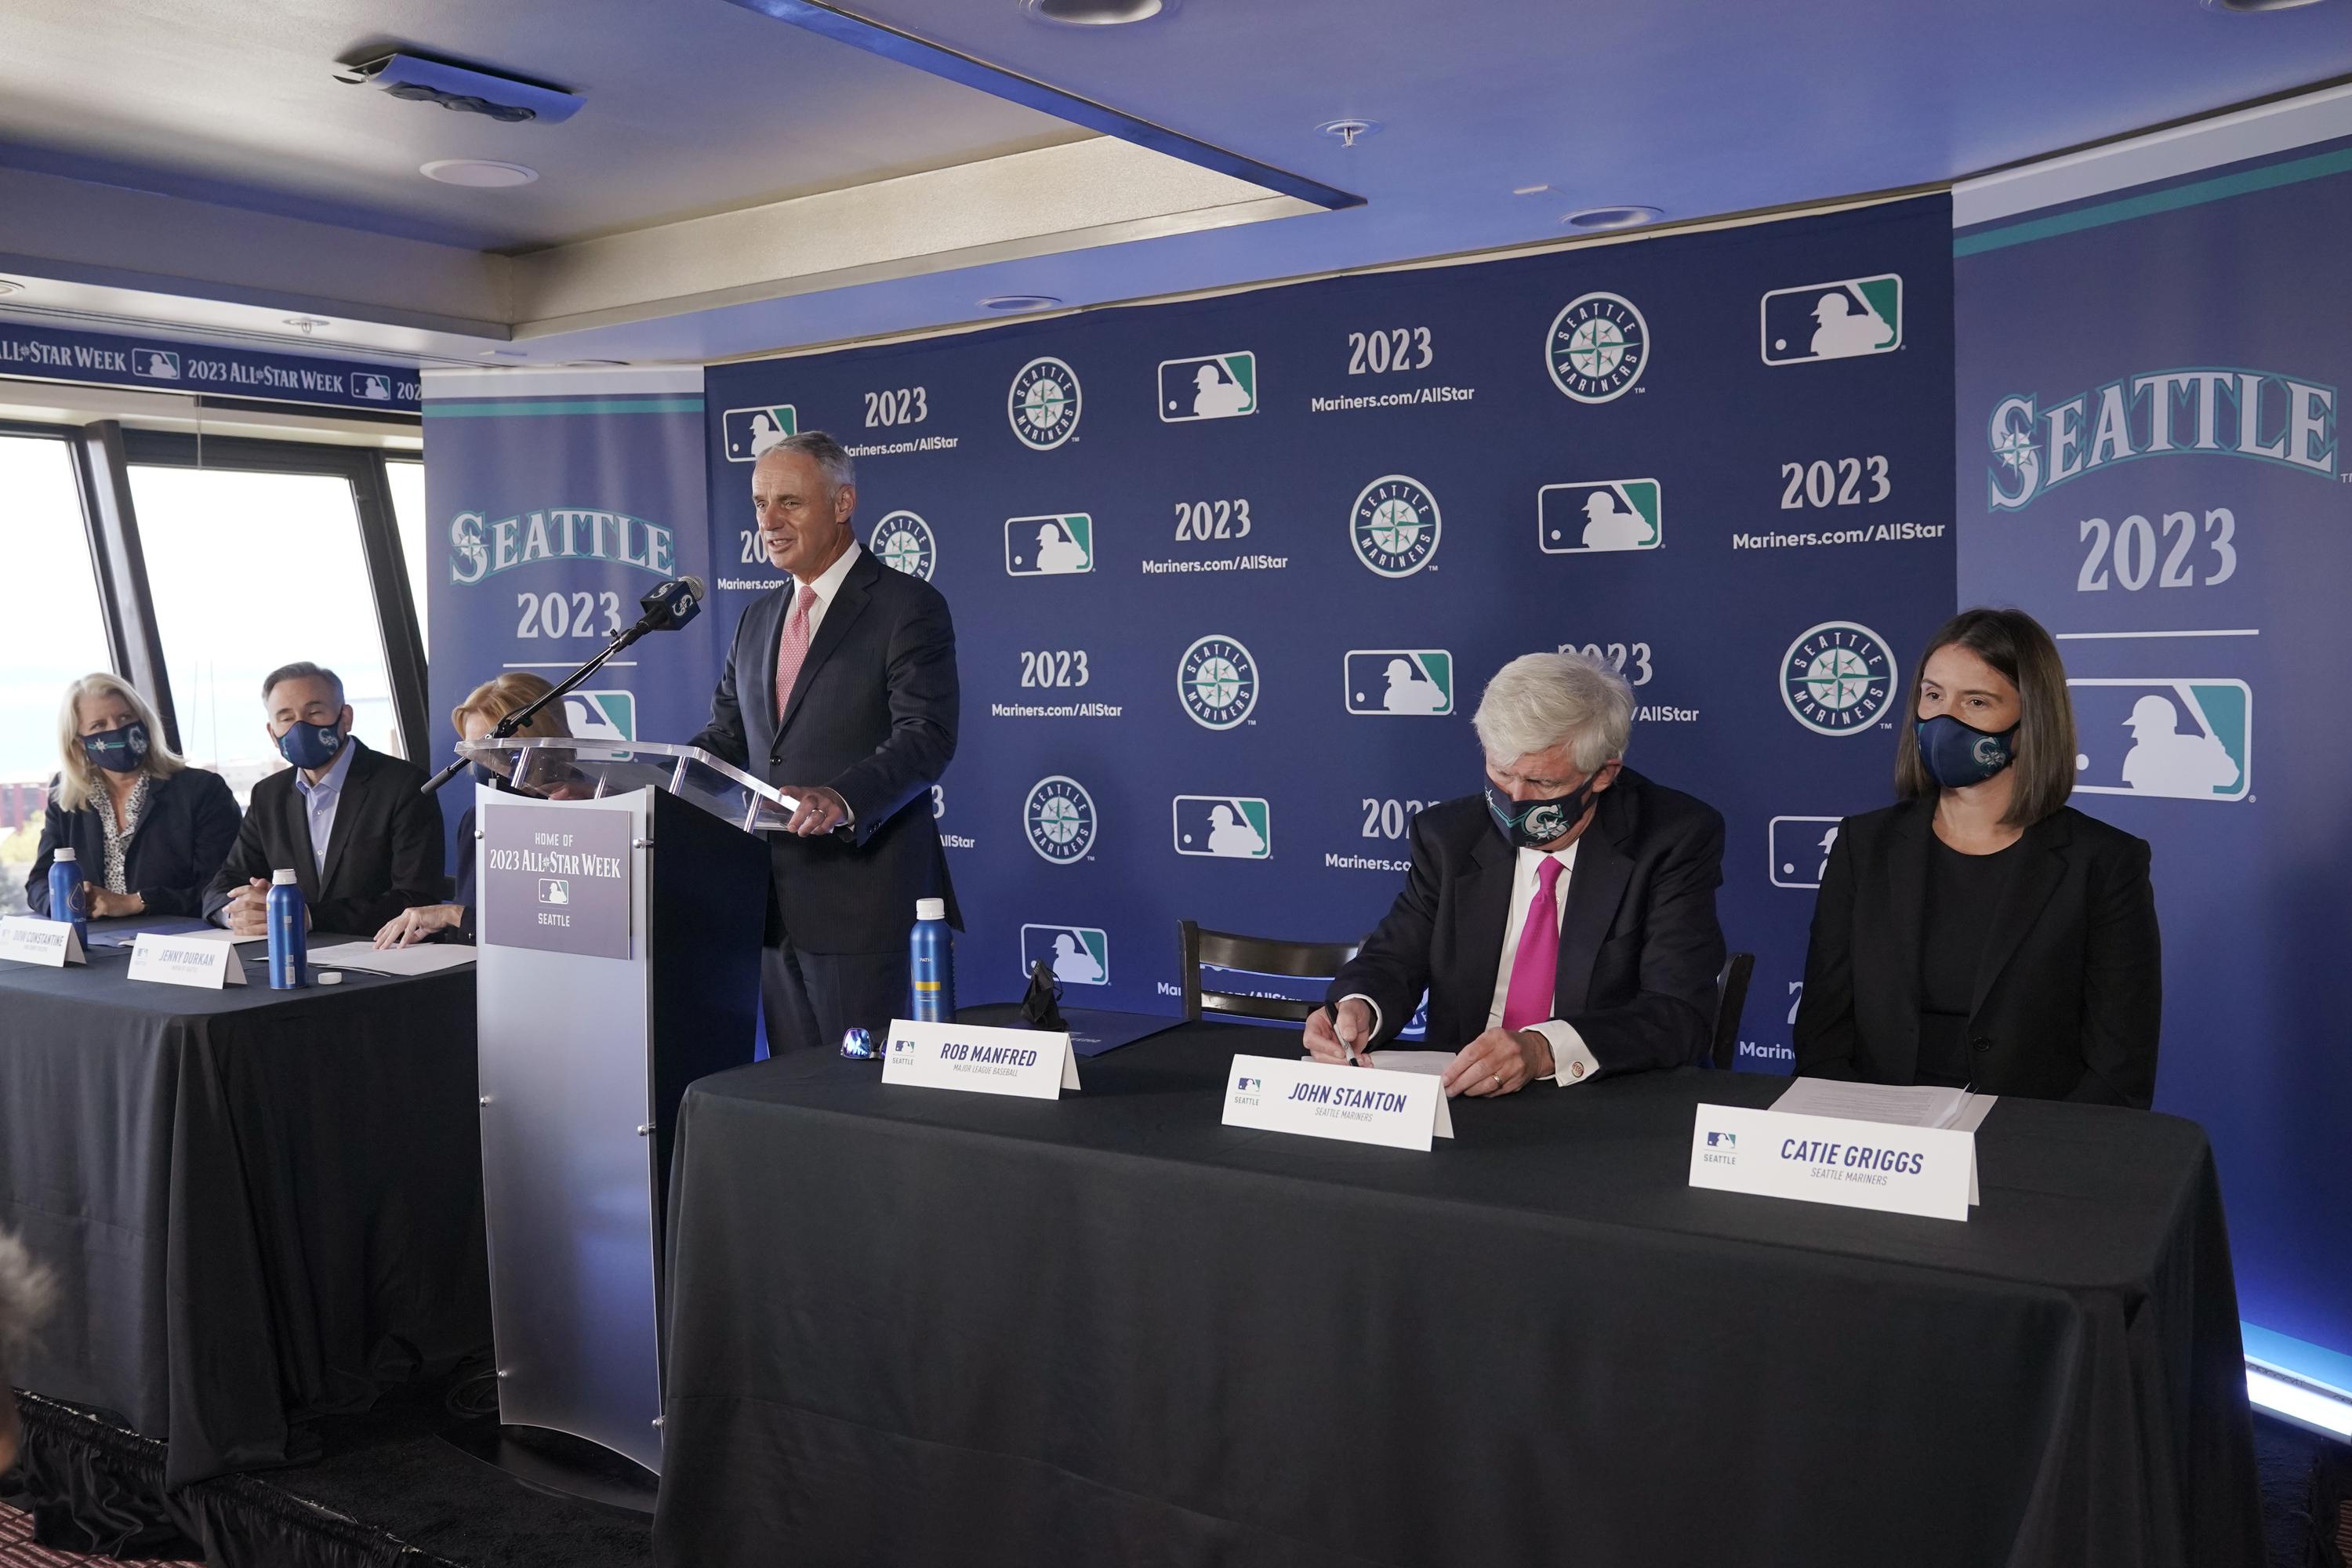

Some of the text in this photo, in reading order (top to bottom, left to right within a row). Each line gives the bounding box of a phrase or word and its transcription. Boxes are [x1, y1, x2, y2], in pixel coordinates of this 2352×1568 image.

[1558, 303, 1635, 339] SEATTLE
[0, 340, 24, 361] LL
[74, 346, 127, 372] WEEK
[1348, 326, 1433, 375] 2023
[188, 359, 227, 381] 2023
[300, 370, 343, 393] WEEK
[1017, 366, 1072, 397] SEATTLE
[1558, 354, 1637, 394] MARINERS
[865, 386, 928, 428] 2023
[1311, 387, 1475, 412] Mariners.com/AllStar
[1017, 409, 1073, 441] MARINERS
[1988, 366, 2337, 513] SEATTLE
[1780, 455, 1891, 510] 2023
[1360, 485, 1429, 517] SEATTLE
[877, 518, 927, 546] SEATTLE
[1174, 499, 1251, 542] 2023
[1733, 522, 1945, 550] Mariners.com/AllStar
[449, 508, 675, 585] SEATTLE
[740, 530, 771, 564] 20
[1361, 533, 1431, 568] MARINERS
[2077, 508, 2238, 592] 2023
[1142, 554, 1288, 574] Mariners.com/AllStar
[717, 576, 791, 590] Mariners.com
[517, 591, 622, 639] 2023
[1187, 644, 1247, 673] SEATTLE
[1558, 642, 1653, 686] 23
[1794, 632, 1882, 668] SEATTLE
[1021, 650, 1089, 688] 2023
[992, 702, 1122, 717] Mariners.com/AllStar
[1188, 690, 1249, 721] MARINERS
[1794, 687, 1883, 724] MARINERS
[1033, 784, 1086, 811] SEATTLE
[535, 833, 574, 847] HOME OF
[1033, 827, 1089, 856] MARINERS
[489, 849, 519, 870] 2023
[581, 853, 621, 878] WEEK
[538, 913, 571, 927] SEATTLE
[158, 949, 216, 967] JENNY DURKAN
[940, 1043, 1037, 1067] ROB MANFRED
[953, 1064, 1018, 1077] MAJOR LEAGUE BASEBALL
[1234, 1096, 1259, 1106] SEATTLE
[1288, 1083, 1407, 1113] JOHN STANTON
[1315, 1106, 1374, 1122] SEATTLE MARINERS
[1704, 1153, 1737, 1166] SEATTLE
[1780, 1138, 1924, 1175] CATIE GRIGGS
[1810, 1167, 1888, 1186] SEATTLE MARINERS
